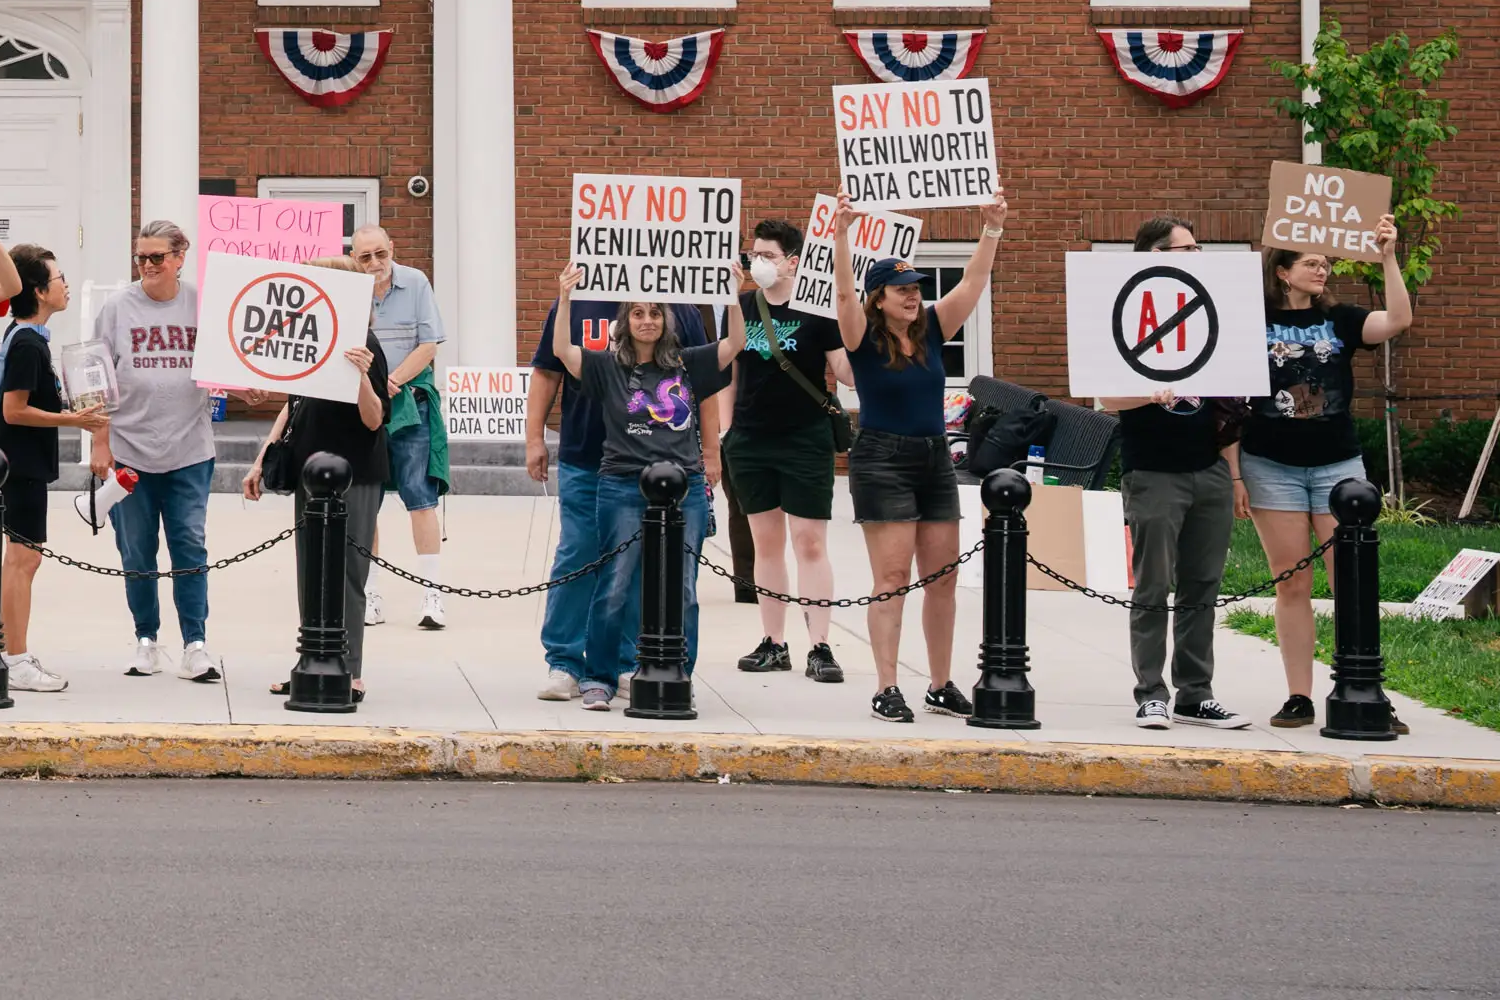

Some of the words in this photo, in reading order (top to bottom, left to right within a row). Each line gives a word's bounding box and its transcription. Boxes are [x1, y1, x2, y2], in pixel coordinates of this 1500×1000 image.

[839, 92, 891, 131] SAY
[902, 90, 941, 128] NO
[949, 88, 984, 125] TO
[843, 131, 989, 167] KENILWORTH
[846, 171, 901, 203] DATA
[907, 166, 993, 199] CENTER
[1304, 172, 1345, 199] NO
[209, 199, 273, 232] GET
[275, 207, 333, 237] OUT
[578, 183, 636, 221] SAY
[646, 185, 687, 223] NO
[698, 187, 734, 224] TO
[1285, 195, 1362, 223] DATA
[576, 226, 733, 260] KENILWORTH
[854, 214, 887, 252] NO
[890, 222, 916, 259] TO
[1272, 218, 1382, 254] CENTER
[266, 282, 306, 309] NO
[575, 262, 630, 292] DATA
[640, 264, 731, 295] CENTER
[795, 275, 833, 308] DATA
[243, 305, 320, 343] DATA
[1137, 290, 1187, 354] AI
[240, 335, 319, 364] CENTER
[448, 371, 482, 393] SAY
[488, 372, 513, 393] NO
[449, 396, 528, 414] KENILWOR
[450, 417, 483, 434] DATA
[488, 417, 527, 435] CENT
